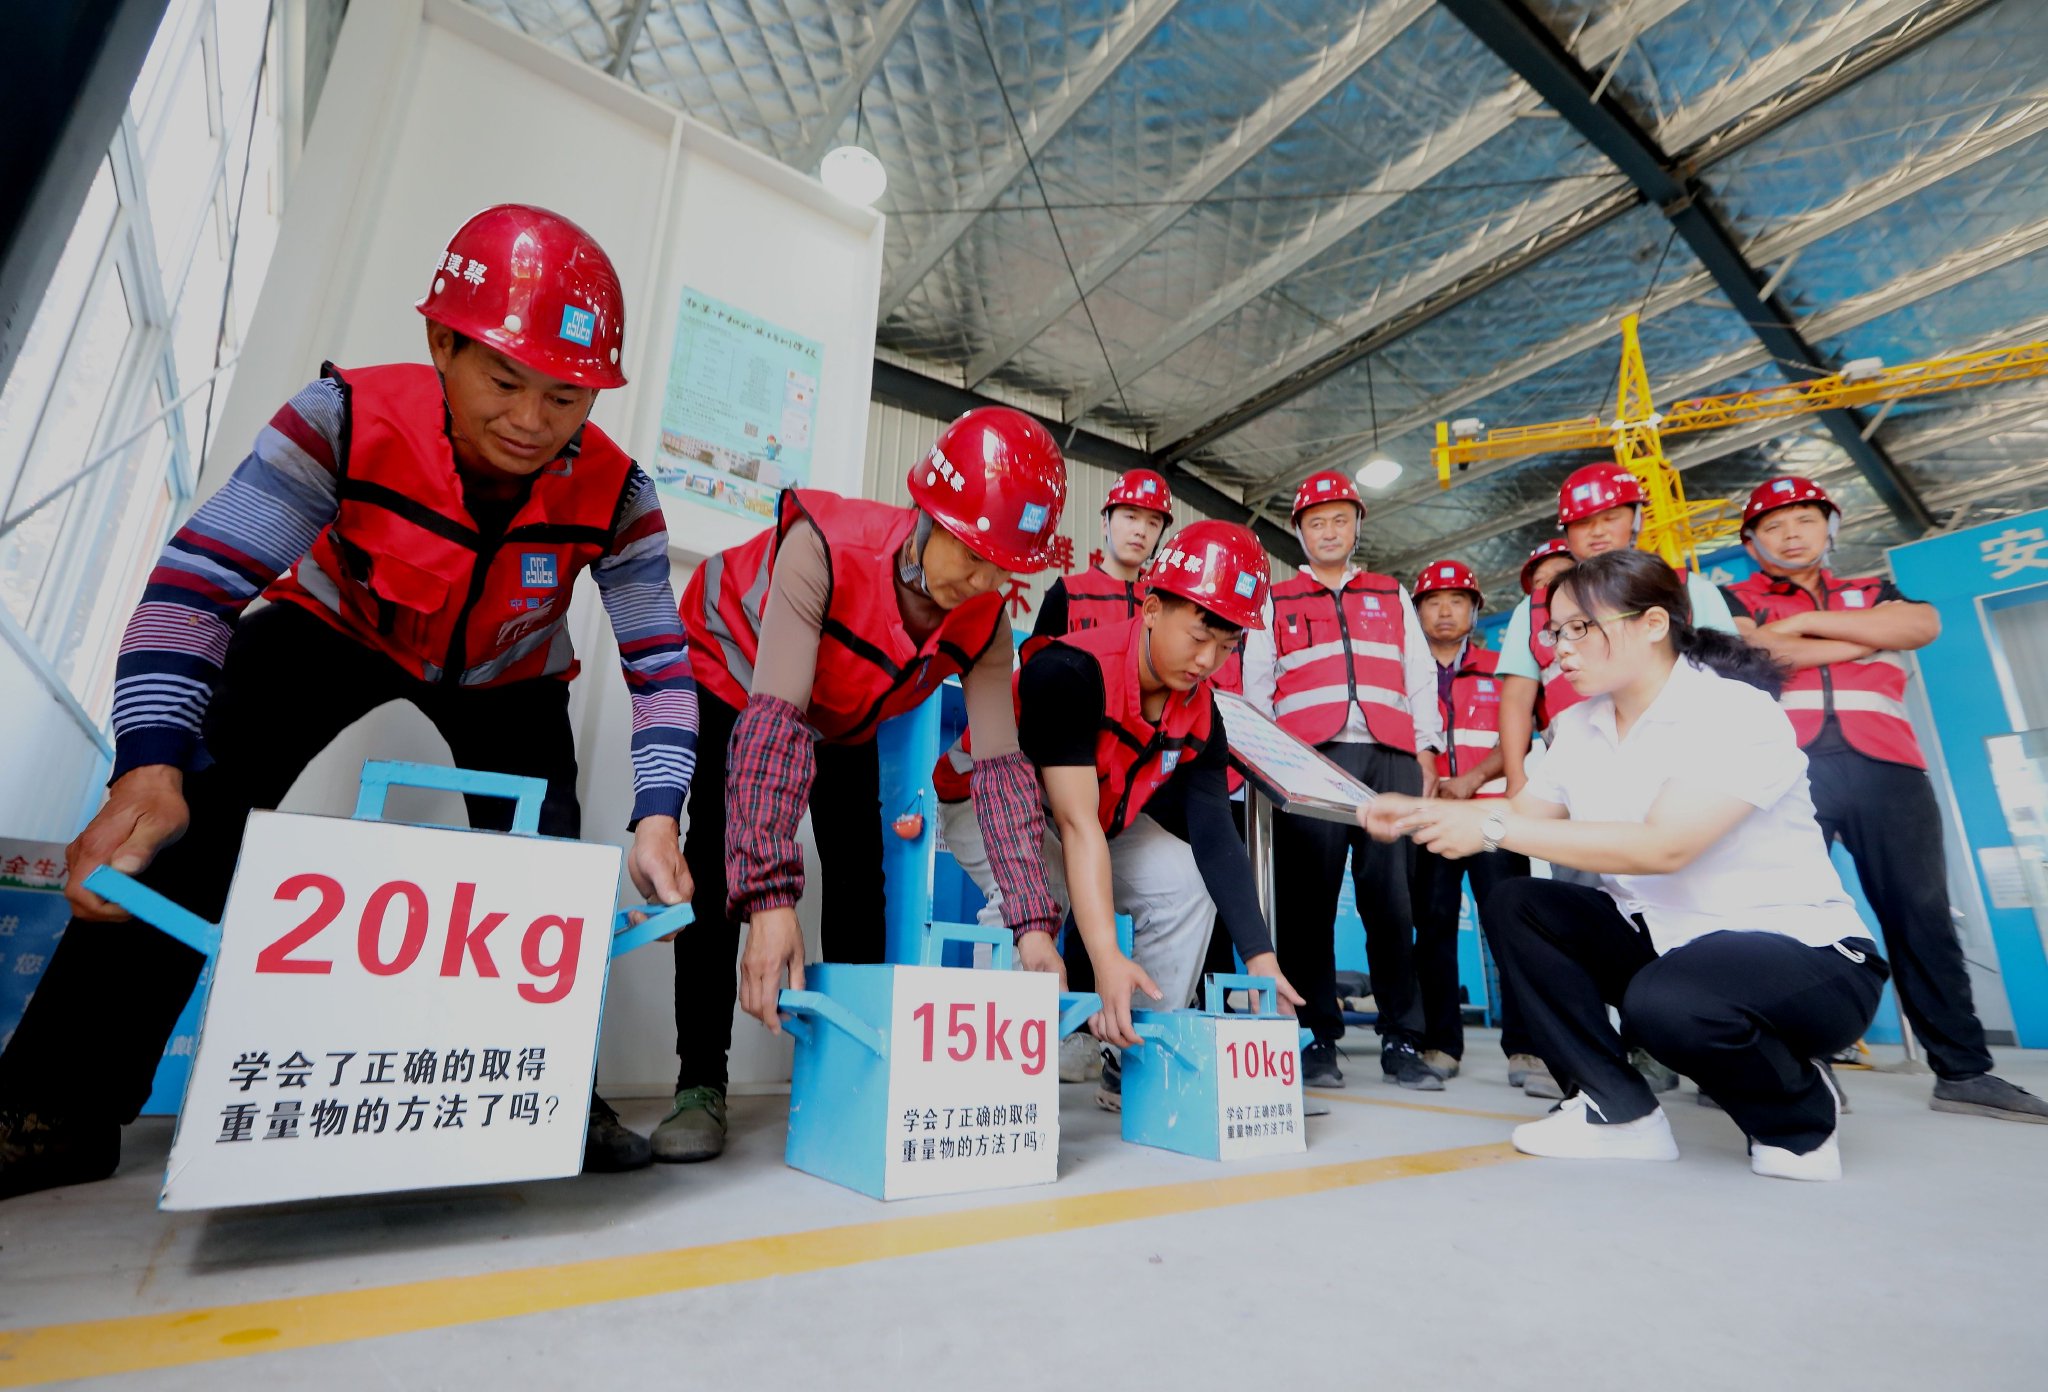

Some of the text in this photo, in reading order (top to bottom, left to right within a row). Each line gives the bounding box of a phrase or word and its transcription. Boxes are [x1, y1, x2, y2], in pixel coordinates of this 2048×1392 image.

[0, 854, 70, 880] 全生
[255, 873, 585, 1004] 20kg
[913, 1001, 1046, 1076] 15kg
[229, 1046, 546, 1091] 学会了正确的取得
[1226, 1040, 1295, 1086] 10kg
[215, 1092, 560, 1144] 重量物的方法了吗?
[903, 1103, 1038, 1132] 学会了正确的取得
[1226, 1103, 1293, 1121] 学会了正确的取得
